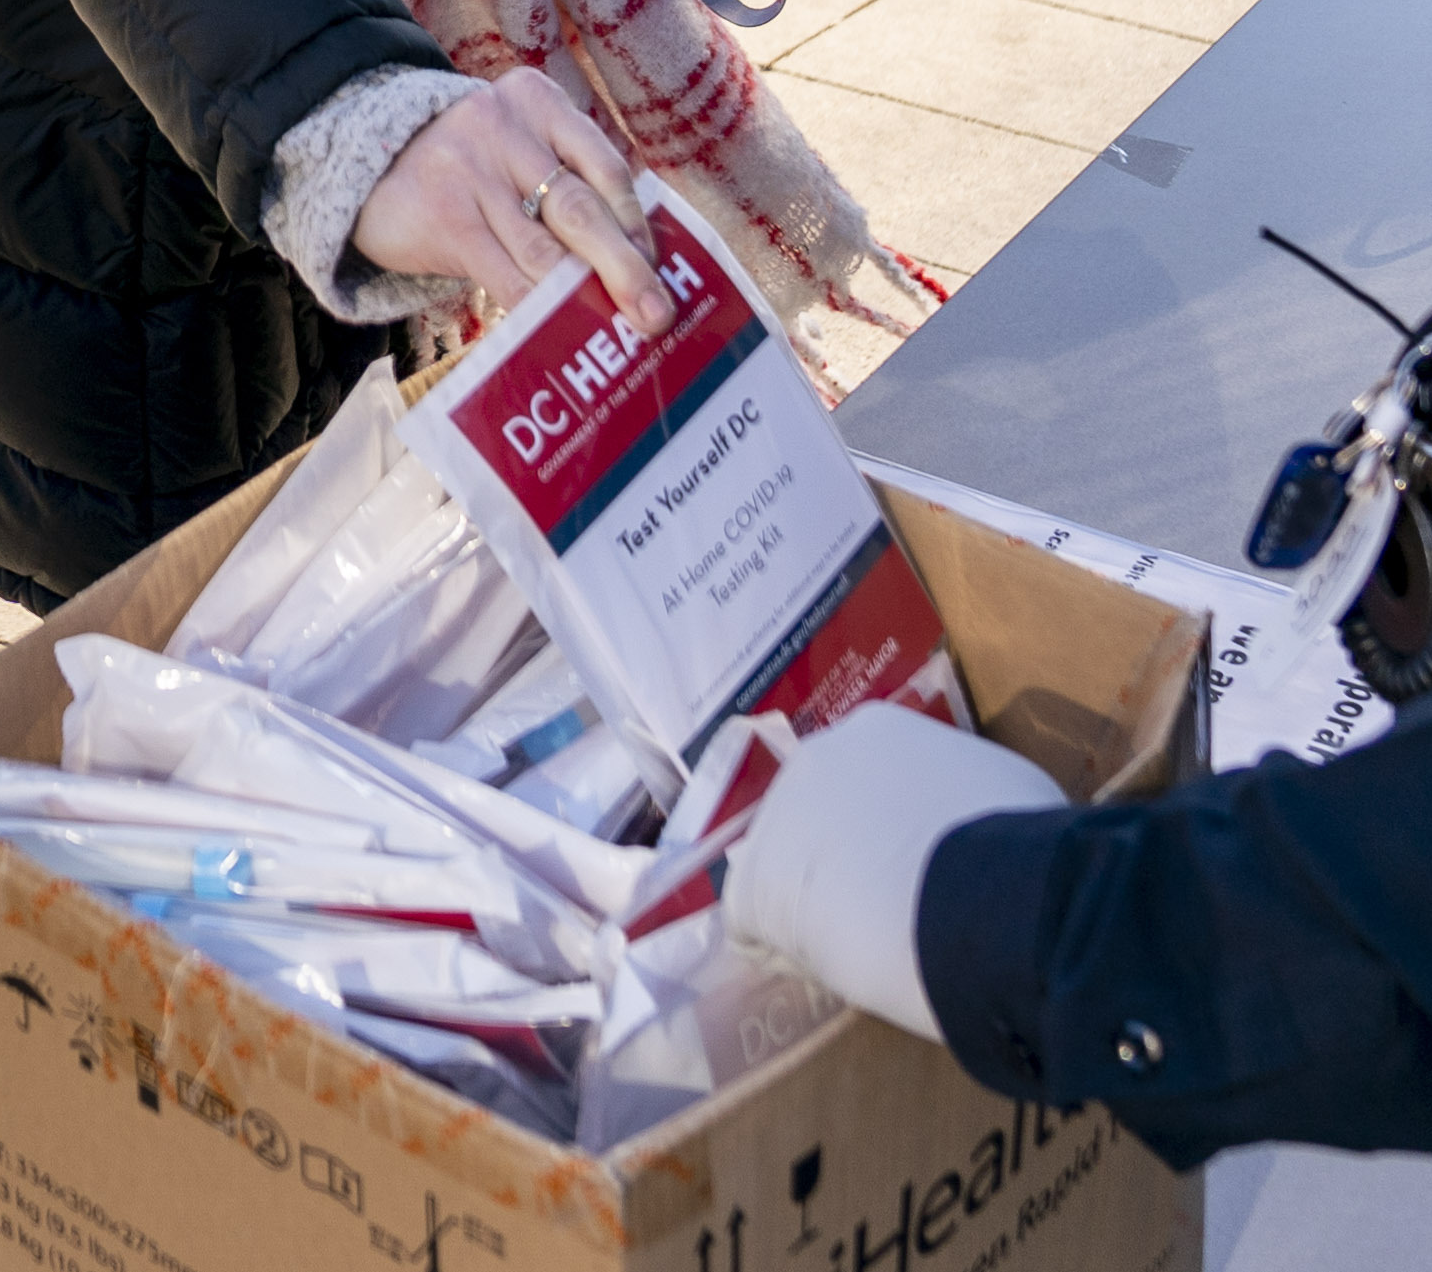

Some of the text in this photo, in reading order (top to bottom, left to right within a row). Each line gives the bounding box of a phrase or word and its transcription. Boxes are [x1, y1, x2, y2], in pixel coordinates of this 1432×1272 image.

[502, 252, 704, 464] DC HEAH
[536, 292, 719, 484] GOVERNMENT OF THE DISTRICT OF COLUMBIA
[615, 397, 762, 557] Test Yourself DC
[661, 463, 796, 615] At Home COVID-19
[706, 524, 785, 610] Testing Kit
[1126, 552, 1158, 587] Visit
[865, 636, 901, 680] MAYOR
[14, 1181, 41, 1224] kg
[16, 1215, 46, 1265] kg
[830, 1100, 1088, 1272] Healt
[1015, 1124, 1104, 1246] Rapid
